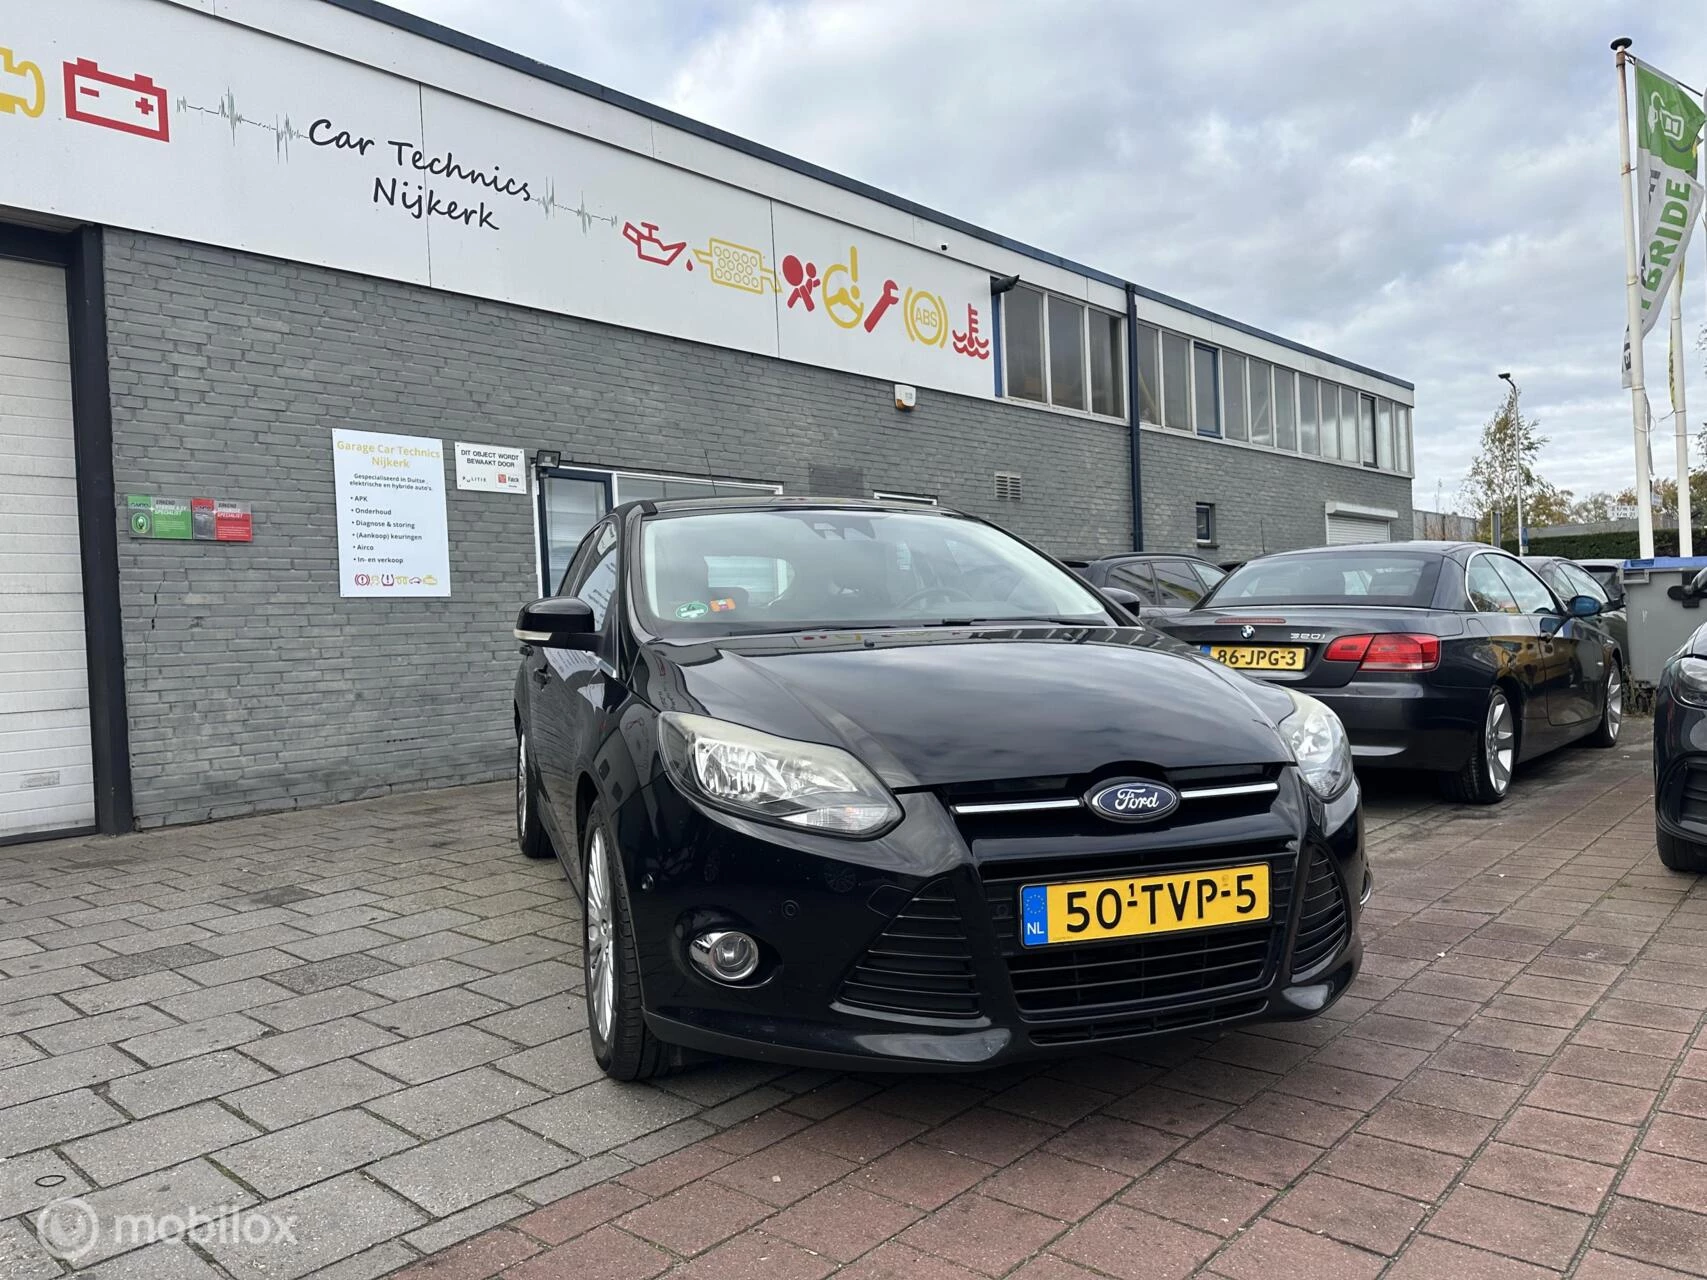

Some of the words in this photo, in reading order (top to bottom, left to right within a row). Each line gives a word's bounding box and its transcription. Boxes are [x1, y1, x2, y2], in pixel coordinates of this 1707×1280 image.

[308, 118, 375, 156] Car
[387, 140, 531, 202] Technics
[373, 177, 500, 230] Nijkerk
[1641, 177, 1691, 310] BRIDE
[915, 307, 938, 328] ABS
[336, 440, 376, 454] Garage
[377, 444, 395, 454] Car
[398, 445, 441, 458] Technics
[472, 450, 497, 459] OBJECT
[497, 453, 519, 461] WORDT
[371, 456, 410, 468] Nijkerk
[466, 457, 496, 466] BEWAAKT
[497, 460, 515, 468] DOOR
[353, 473, 400, 482] Gespecialiseerd
[349, 480, 382, 488] elektrische
[391, 482, 414, 491] hybride
[355, 507, 392, 515] Onderhoud
[355, 520, 385, 528] Diagnose
[356, 532, 390, 540] (Aankoop)
[390, 533, 423, 541] keuringen
[1290, 632, 1326, 640] 320i
[1216, 649, 1297, 666] 86-JPG-3
[1114, 787, 1160, 811] Ford
[1026, 922, 1045, 935] NL
